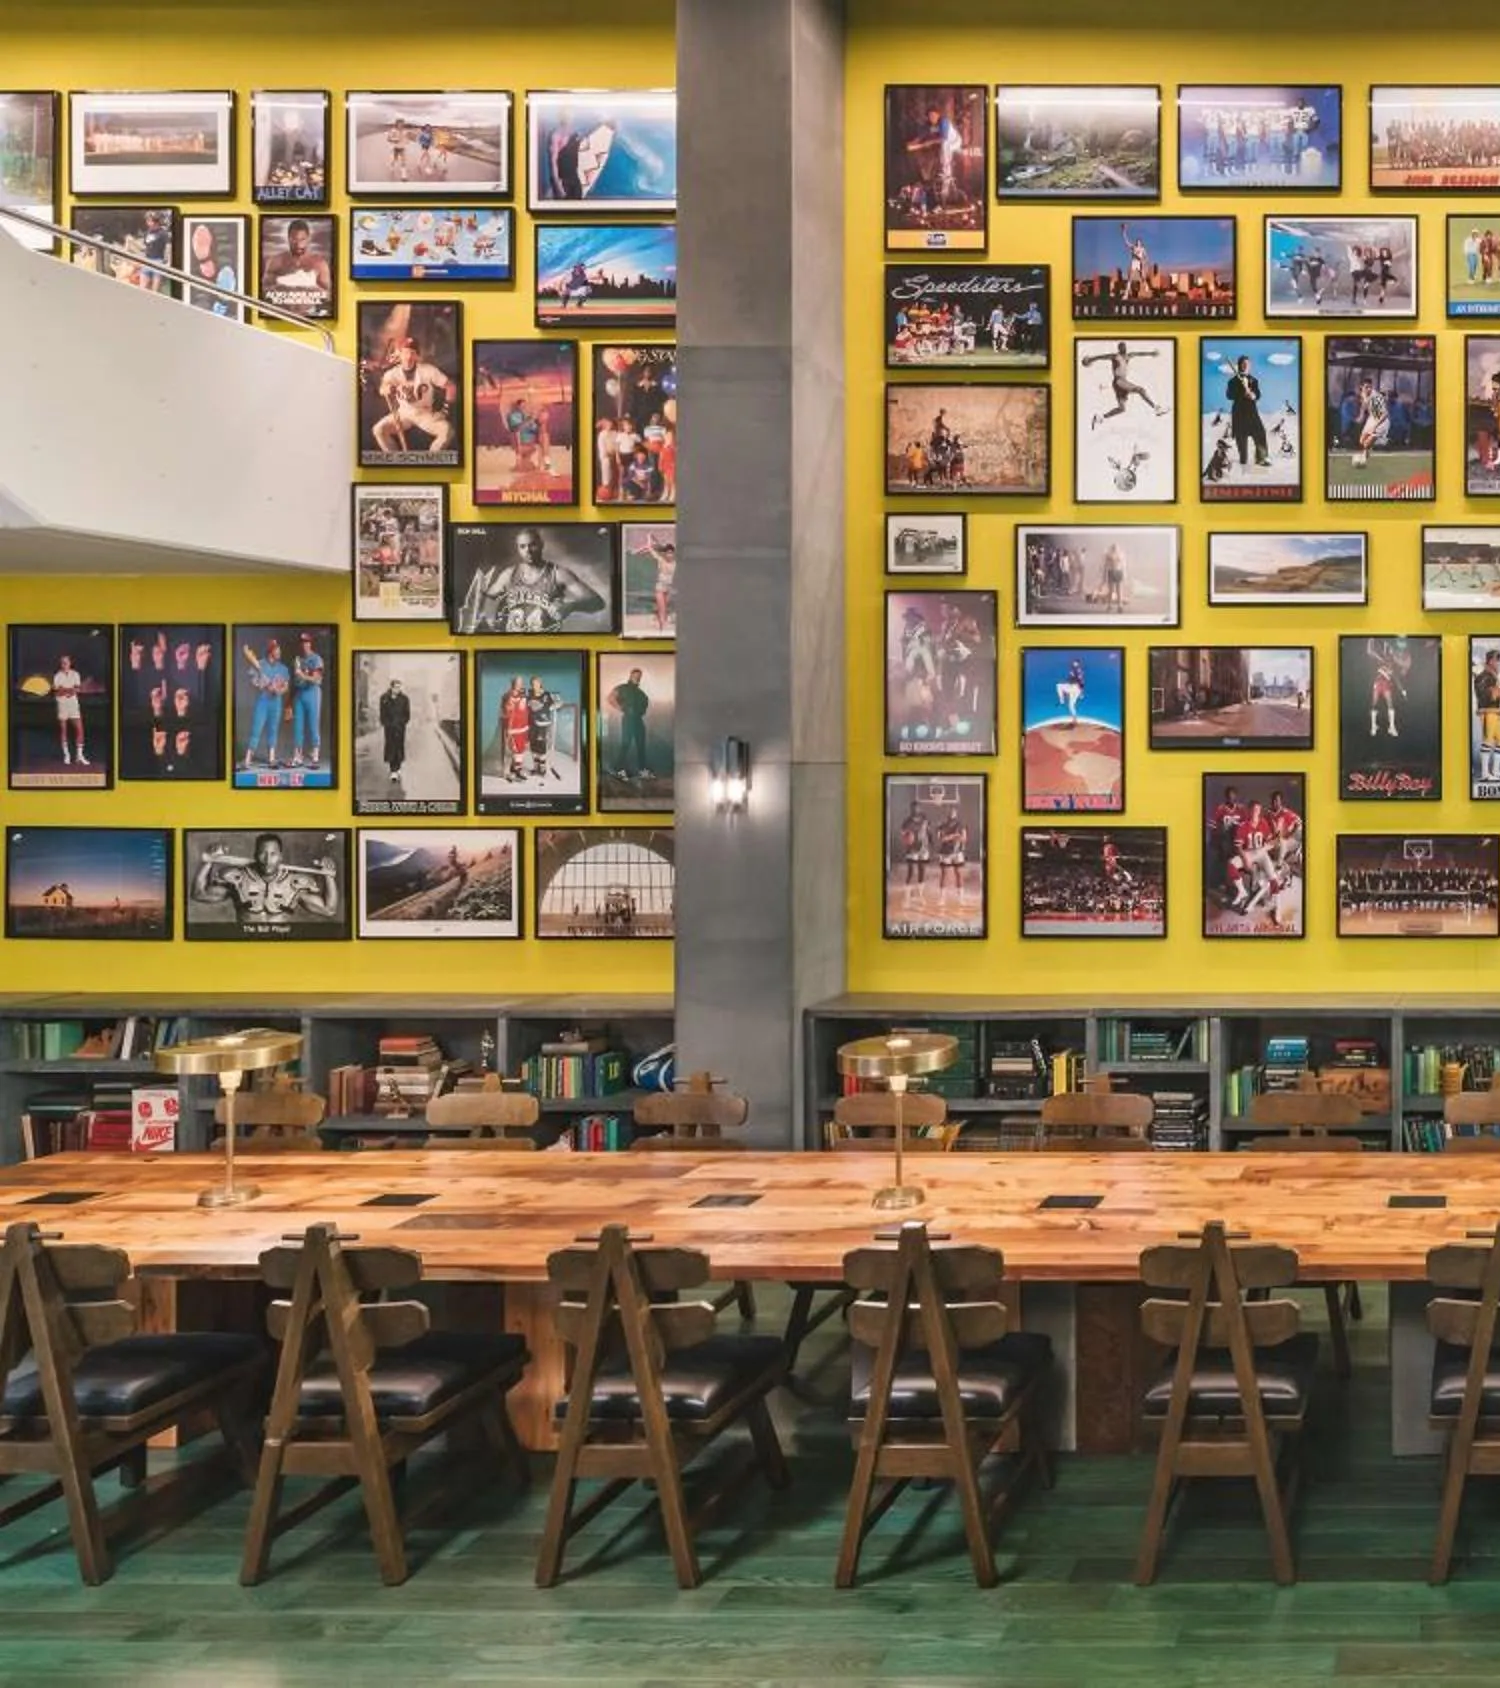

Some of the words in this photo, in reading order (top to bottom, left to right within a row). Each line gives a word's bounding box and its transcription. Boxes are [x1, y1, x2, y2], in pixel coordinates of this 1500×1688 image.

[257, 188, 290, 199] ALLEY
[295, 188, 320, 199] CAT
[892, 273, 1043, 300] Speedsters
[1247, 832, 1264, 849] 10
[890, 923, 920, 935] AIR
[924, 923, 977, 935] FORCE
[141, 1125, 174, 1141] NIKE
